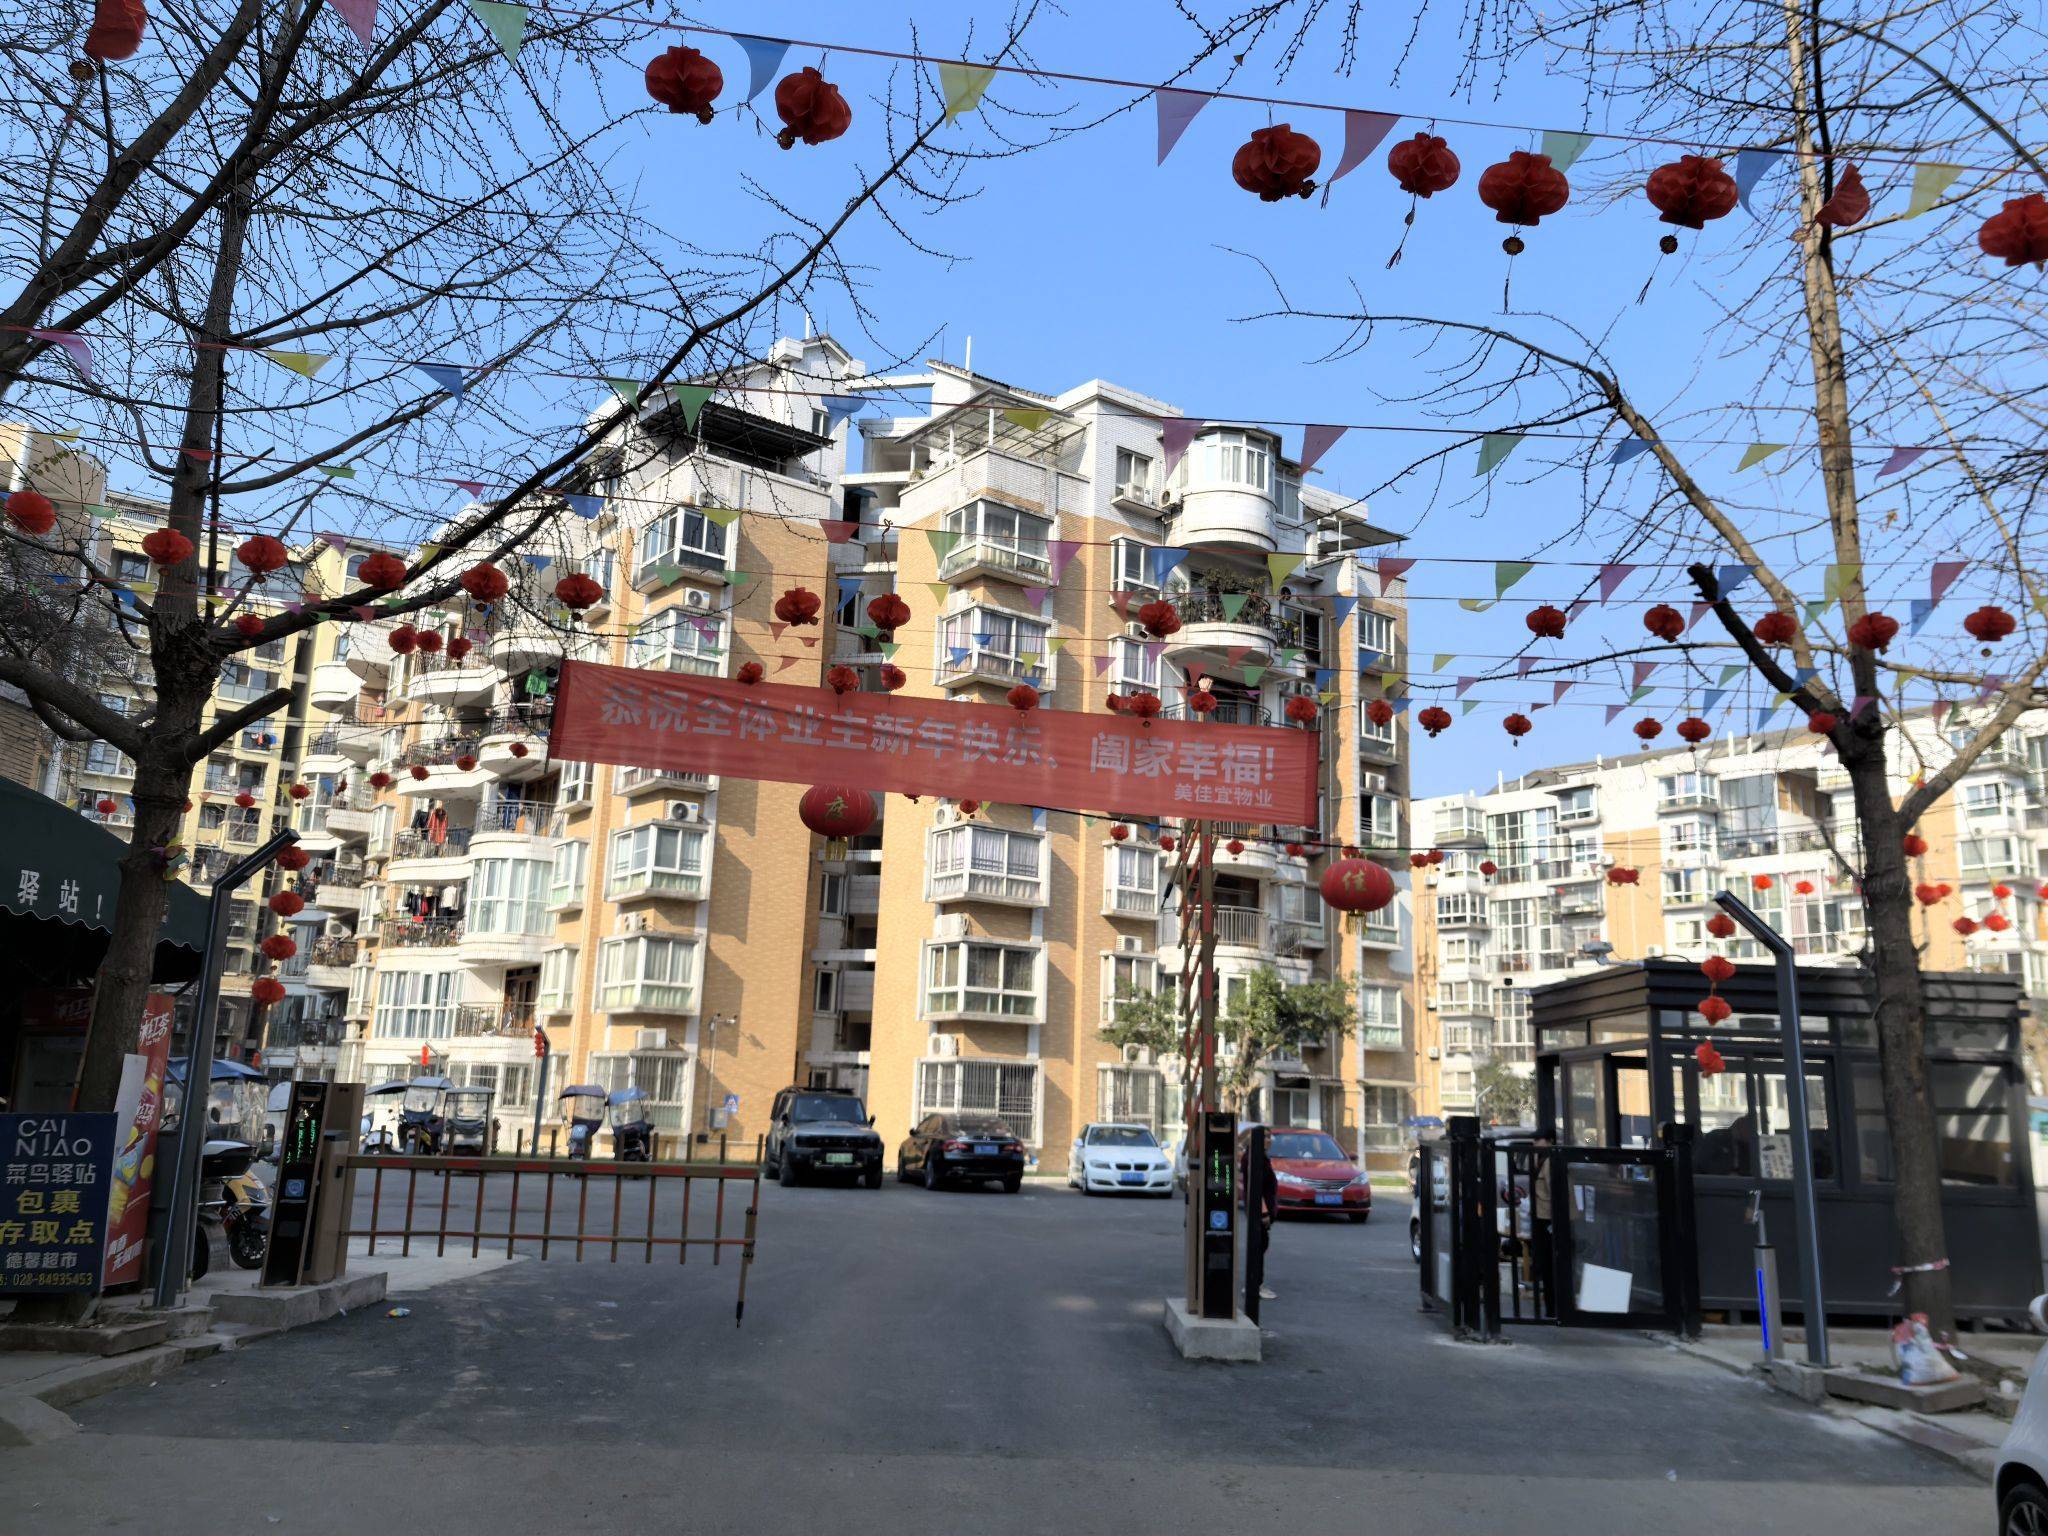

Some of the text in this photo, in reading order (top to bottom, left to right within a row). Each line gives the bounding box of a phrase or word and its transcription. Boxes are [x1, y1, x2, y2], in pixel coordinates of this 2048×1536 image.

[1174, 782, 1273, 808] 美佳宜物业
[18, 1119, 67, 1137] CAI
[15, 1133, 92, 1156] NIAO
[5, 1163, 97, 1184] 菜鸟驿站
[16, 1189, 81, 1214] 包裹
[0, 1220, 96, 1245] 存取点
